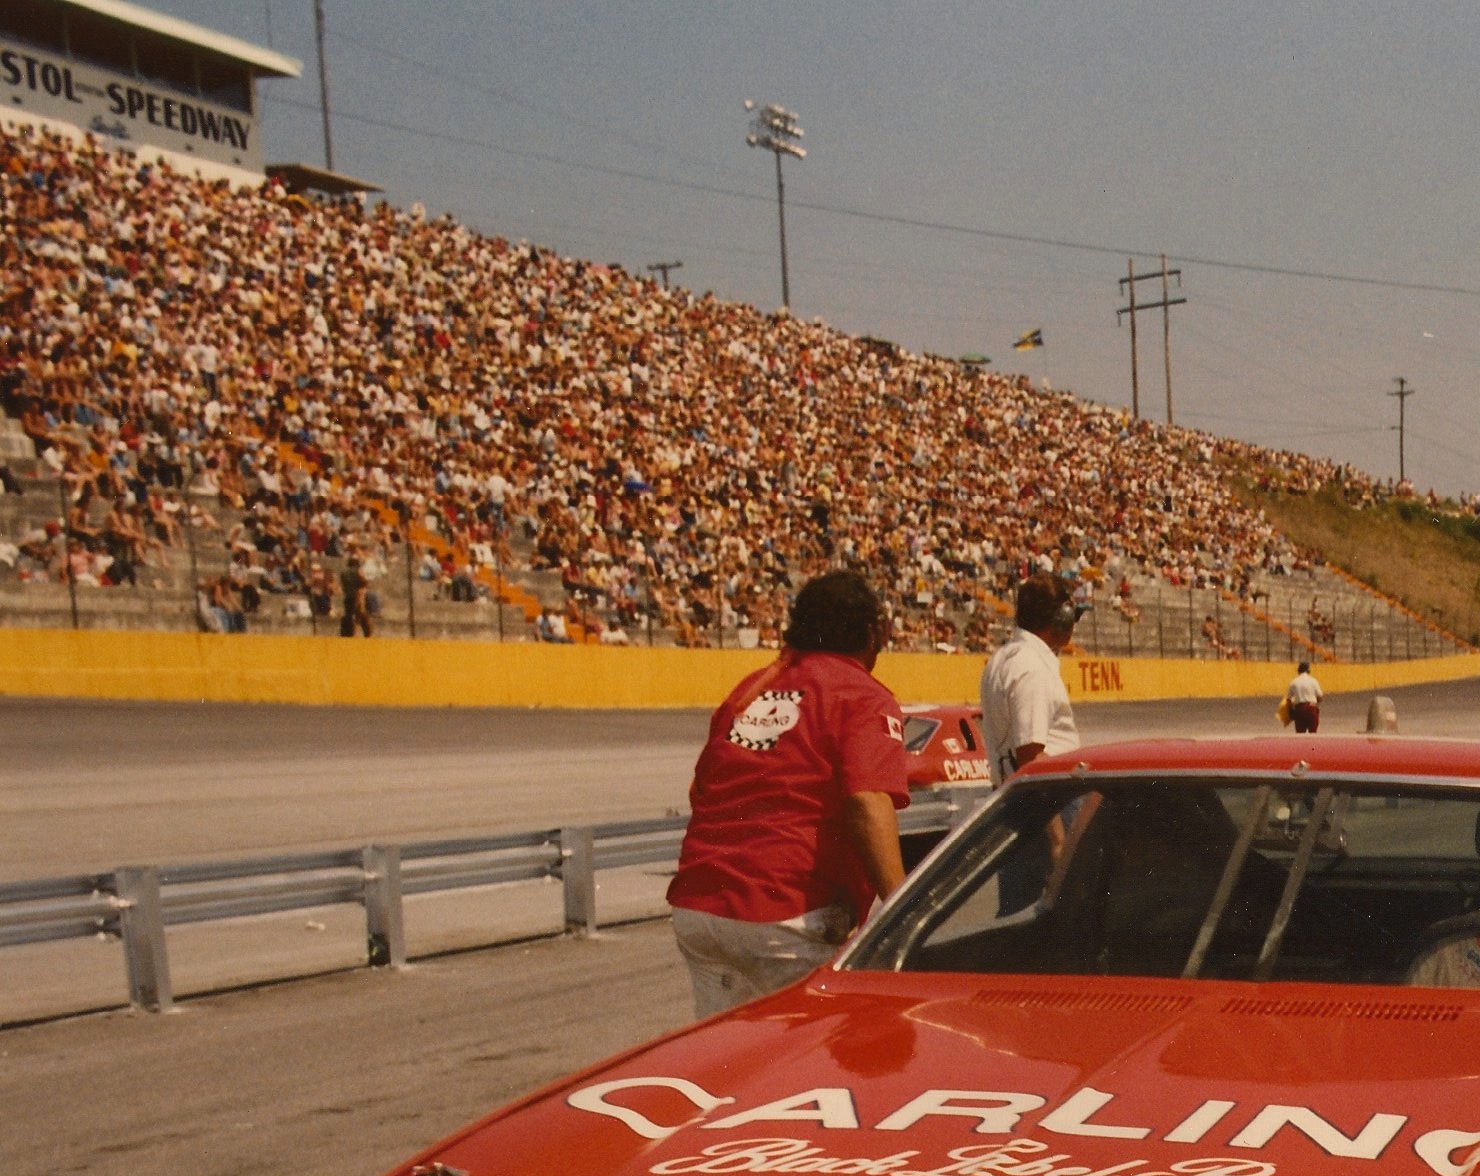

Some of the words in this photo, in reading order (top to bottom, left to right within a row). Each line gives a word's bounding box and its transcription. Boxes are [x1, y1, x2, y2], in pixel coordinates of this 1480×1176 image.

[107, 83, 250, 151] SPEEDWAY
[1078, 661, 1124, 692] TENN.
[648, 1137, 922, 1176] Black
